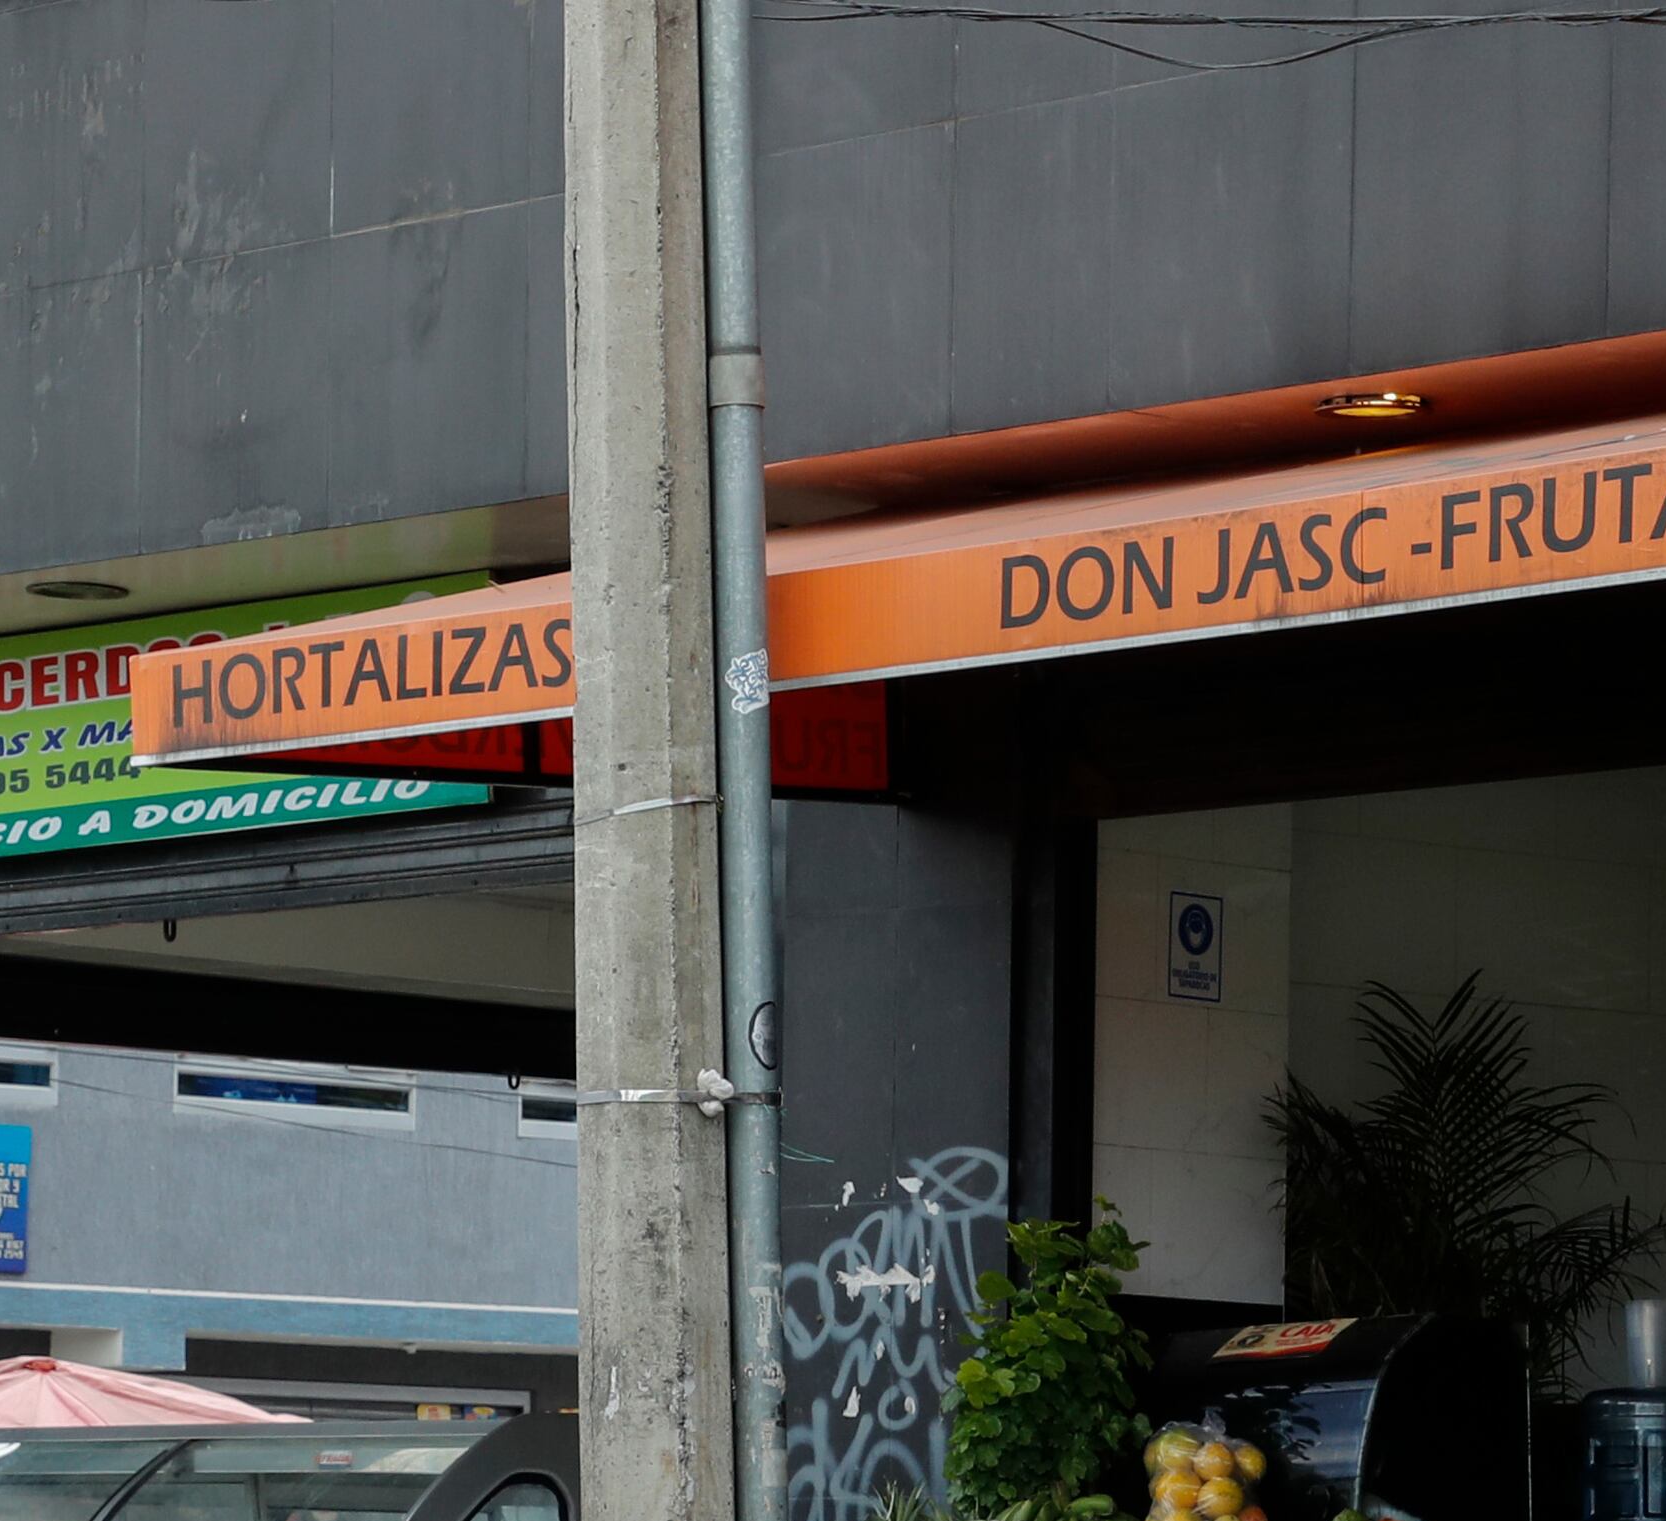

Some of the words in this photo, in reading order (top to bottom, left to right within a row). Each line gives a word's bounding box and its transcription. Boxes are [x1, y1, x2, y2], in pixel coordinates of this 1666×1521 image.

[1000, 536, 1174, 629] DON
[1195, 507, 1387, 605] JASC
[172, 617, 573, 728] HORTALIZAS
[41, 726, 67, 752] X
[79, 809, 111, 836] A
[133, 778, 430, 829] DOMICILIO
